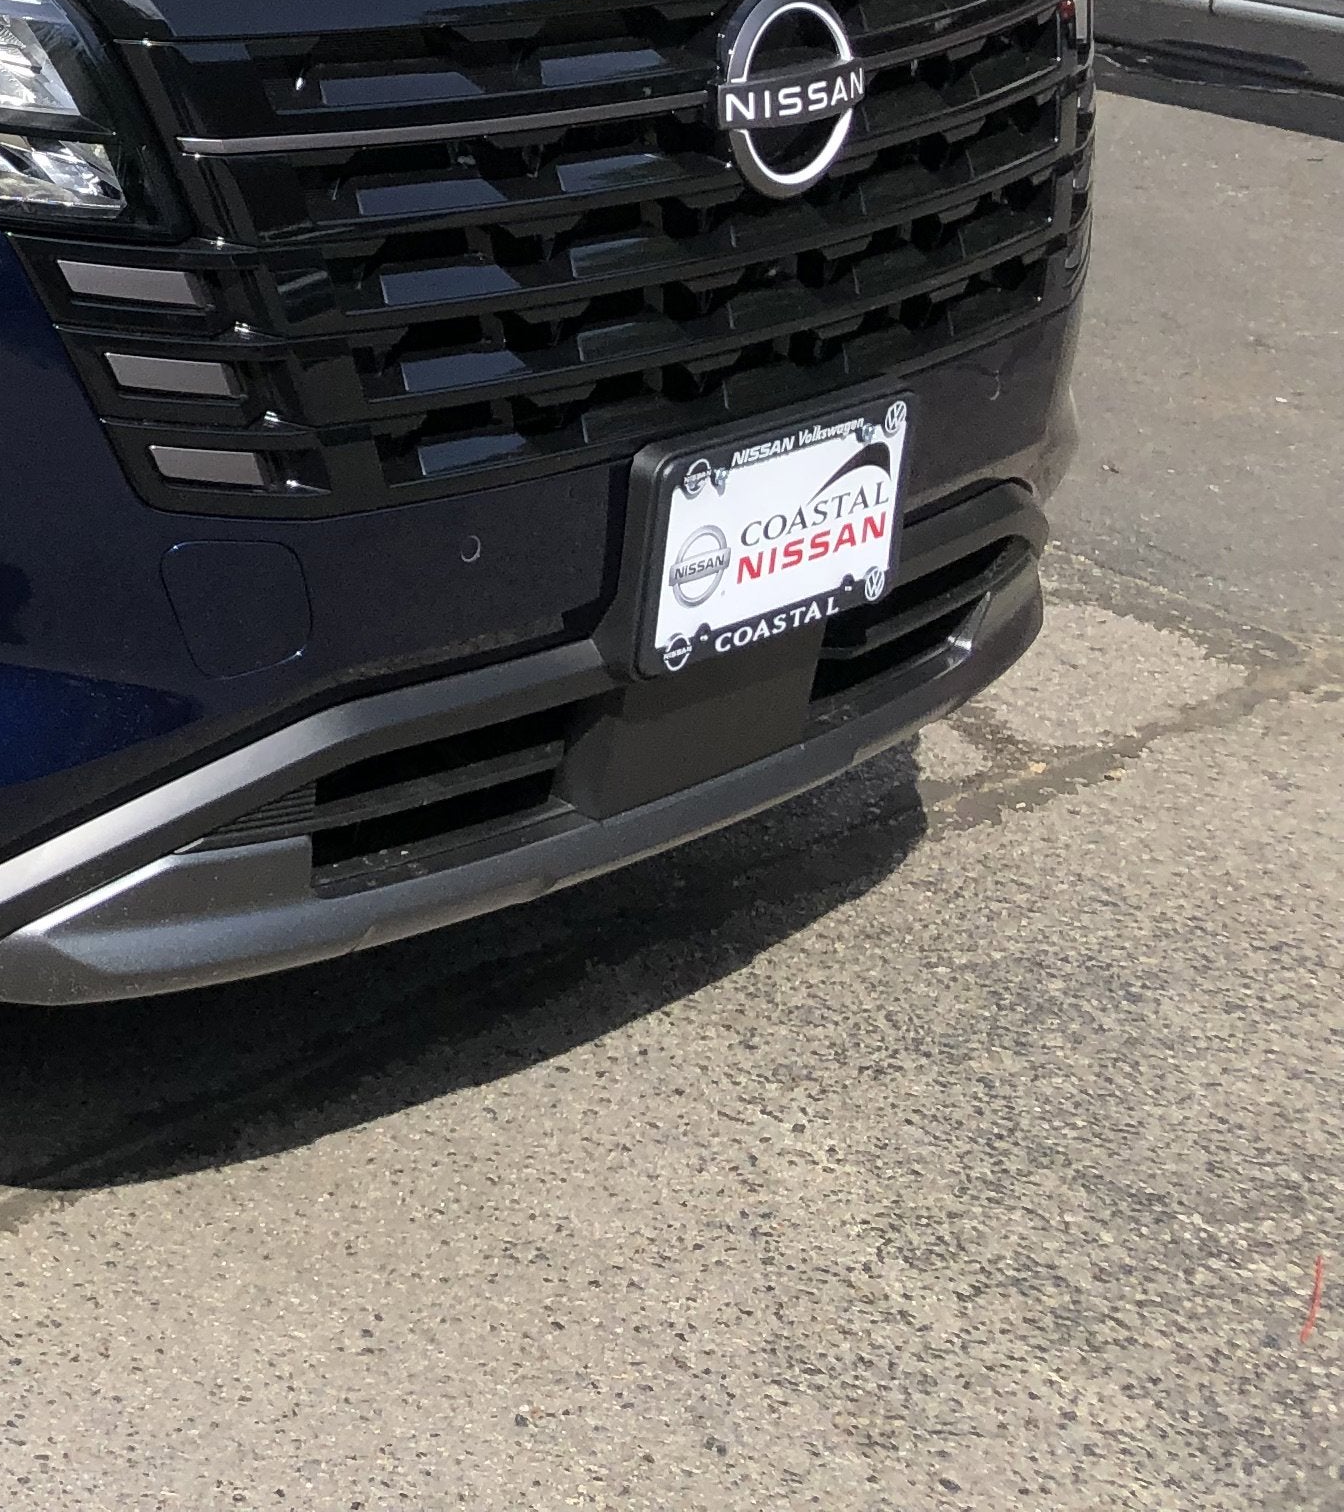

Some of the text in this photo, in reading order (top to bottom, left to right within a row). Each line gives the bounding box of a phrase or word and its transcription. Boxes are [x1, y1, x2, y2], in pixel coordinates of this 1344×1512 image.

[726, 68, 863, 121] NISSAN
[731, 417, 864, 467] NISSAN Volkswagen
[740, 482, 889, 547] COASTAL
[674, 554, 725, 580] NISSAN
[736, 512, 887, 584] NISSAN
[715, 597, 839, 652] COASTAL
